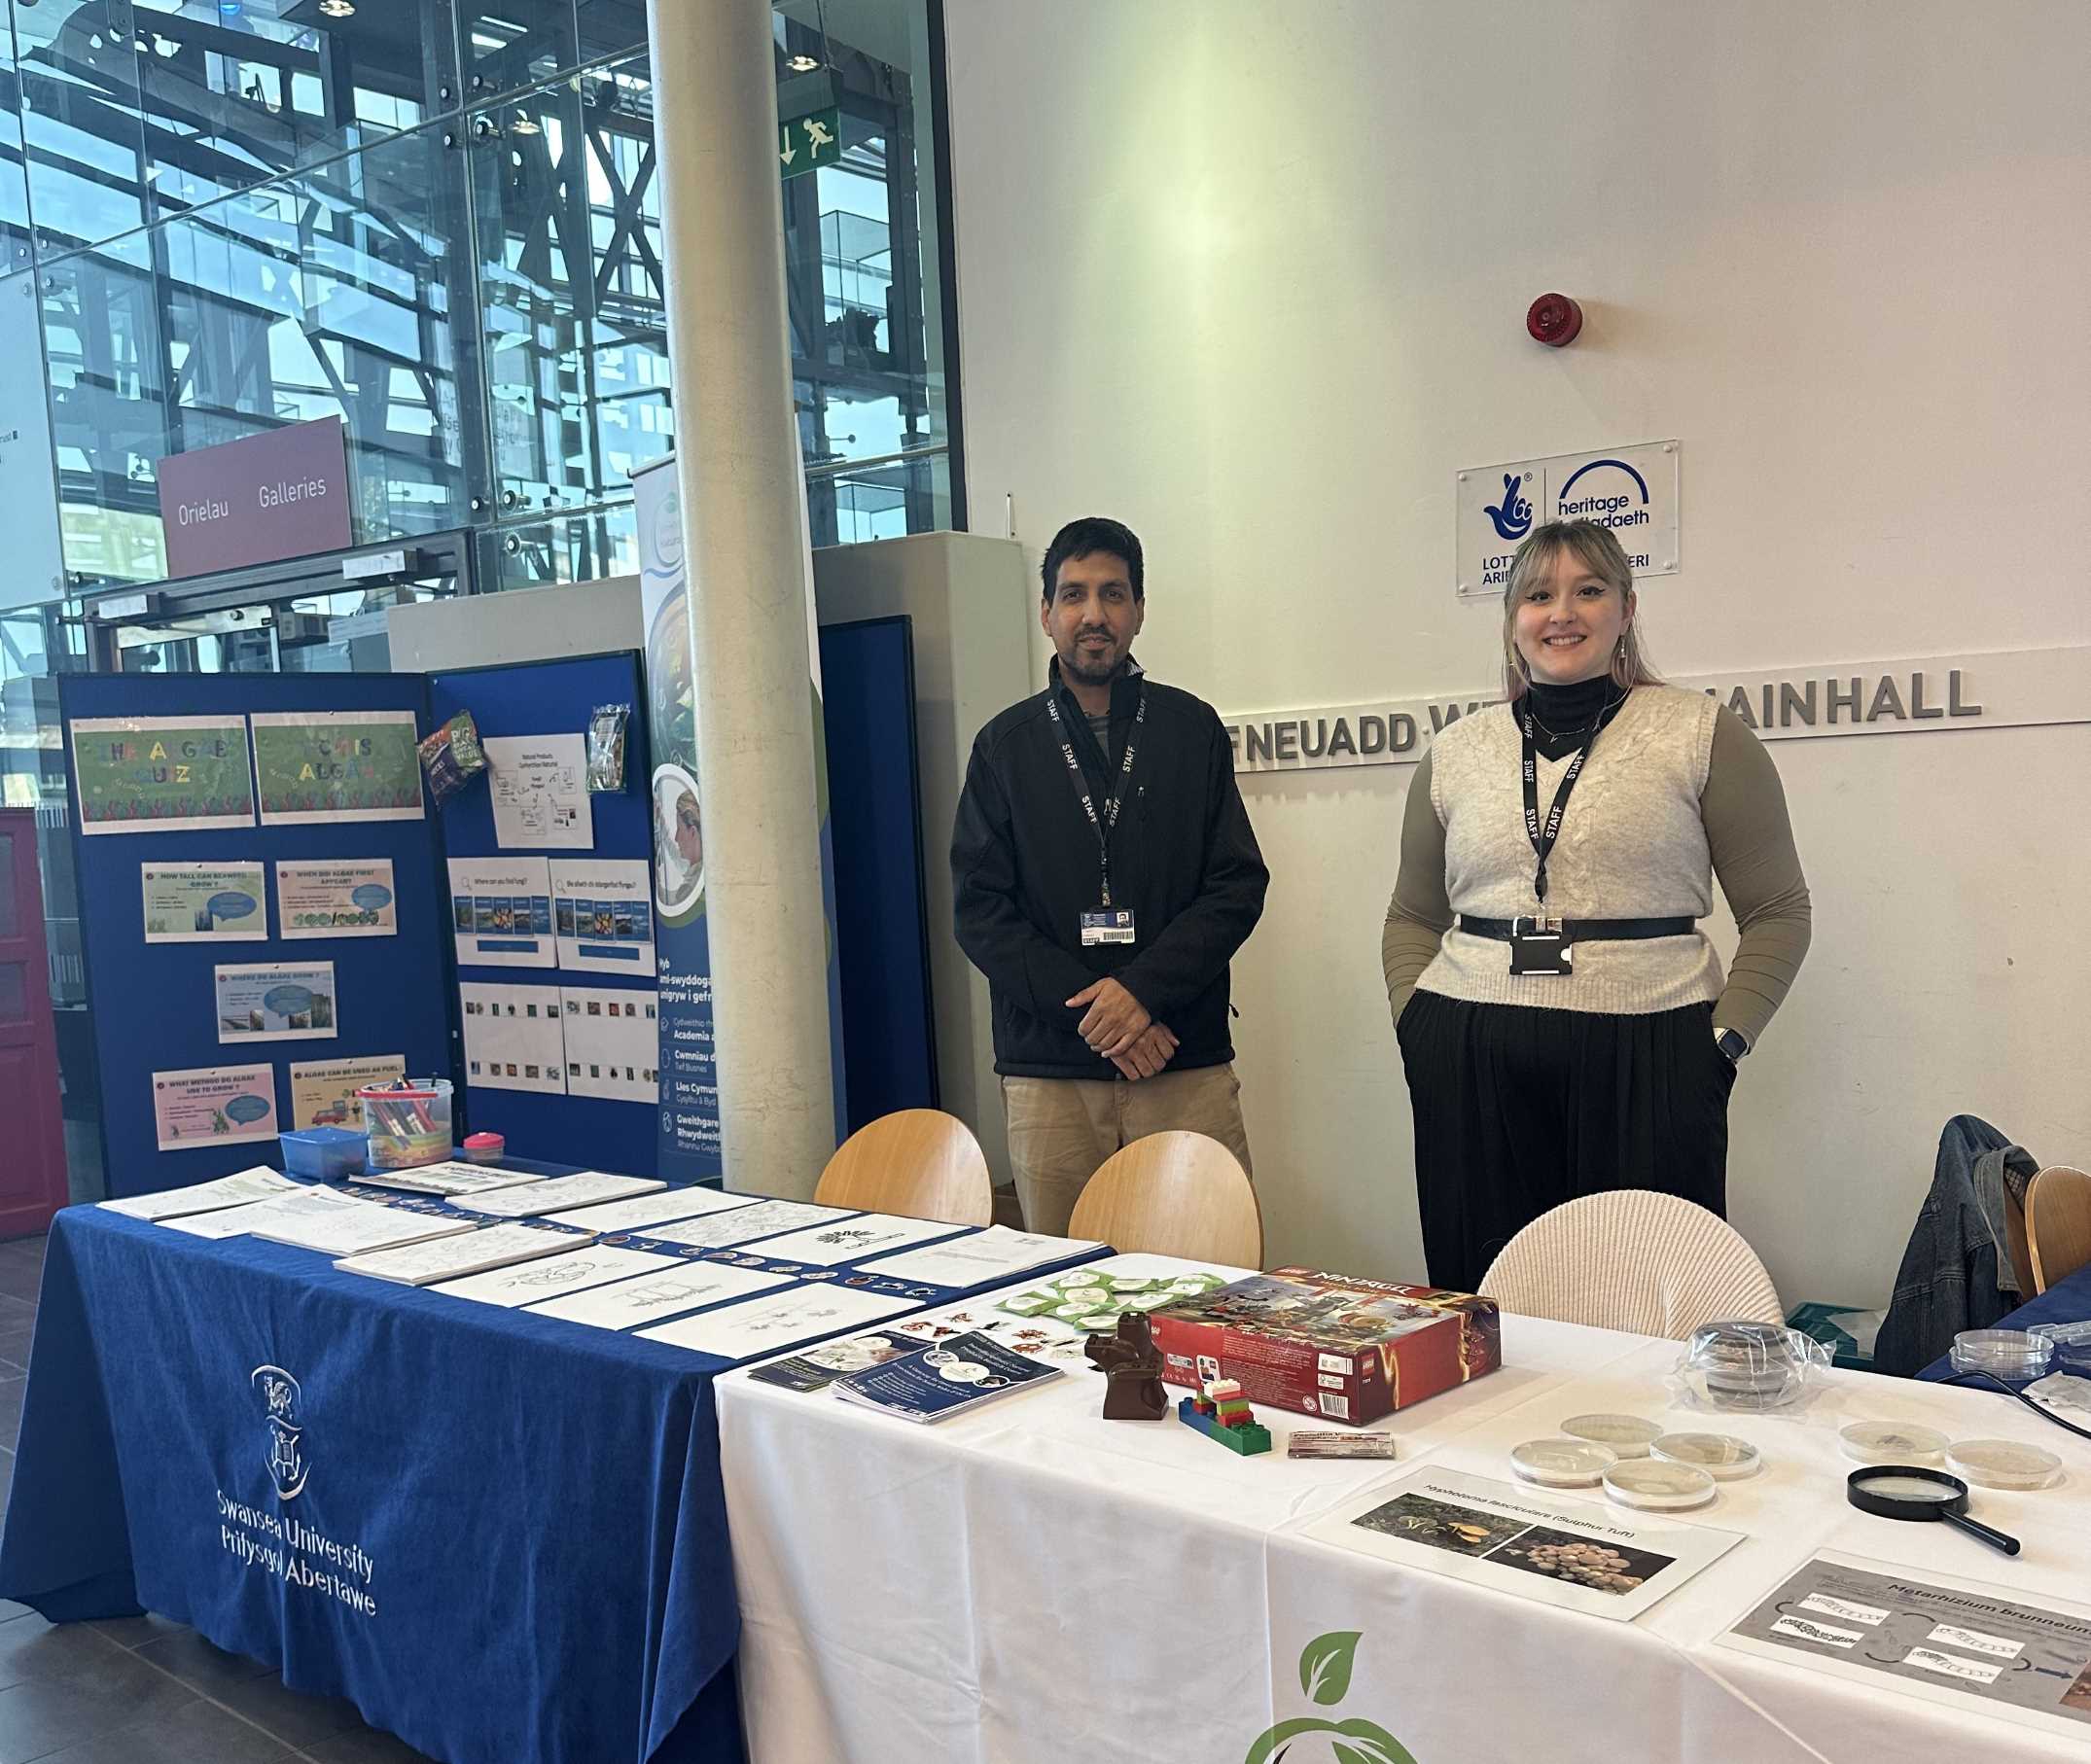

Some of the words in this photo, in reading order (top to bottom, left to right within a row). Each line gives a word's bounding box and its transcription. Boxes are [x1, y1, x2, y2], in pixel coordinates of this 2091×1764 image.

[178, 498, 230, 526] Orielau
[259, 476, 328, 508] Galleries
[1558, 495, 1630, 516] heritage
[1626, 554, 1649, 568] ERI
[1046, 699, 1060, 723] STAFF
[1706, 669, 1982, 729] AINHALL
[149, 739, 228, 761] AGE
[1062, 743, 1079, 771] STAFF
[1122, 745, 1136, 772] STAFF
[135, 764, 191, 783] UZ
[1524, 759, 1533, 783] STAFF
[1566, 755, 1585, 779] STAFF
[1081, 795, 1098, 825] STAFF
[1109, 796, 1121, 827] STAFF
[1526, 808, 1540, 840] STAFF
[1545, 805, 1563, 839] STAFF
[674, 1030, 710, 1041] Academia
[675, 1050, 709, 1062] Cwmniau
[1487, 1499, 1552, 1519] fasciculare
[1552, 1515, 1604, 1531] (Sulphur
[1605, 1528, 1638, 1539] Tuft)
[216, 1489, 283, 1540] Swansea
[285, 1519, 374, 1585] University
[222, 1524, 284, 1576] Prifysgol
[285, 1556, 376, 1617] Abertawe
[1888, 1583, 1997, 1612] Metarhizium
